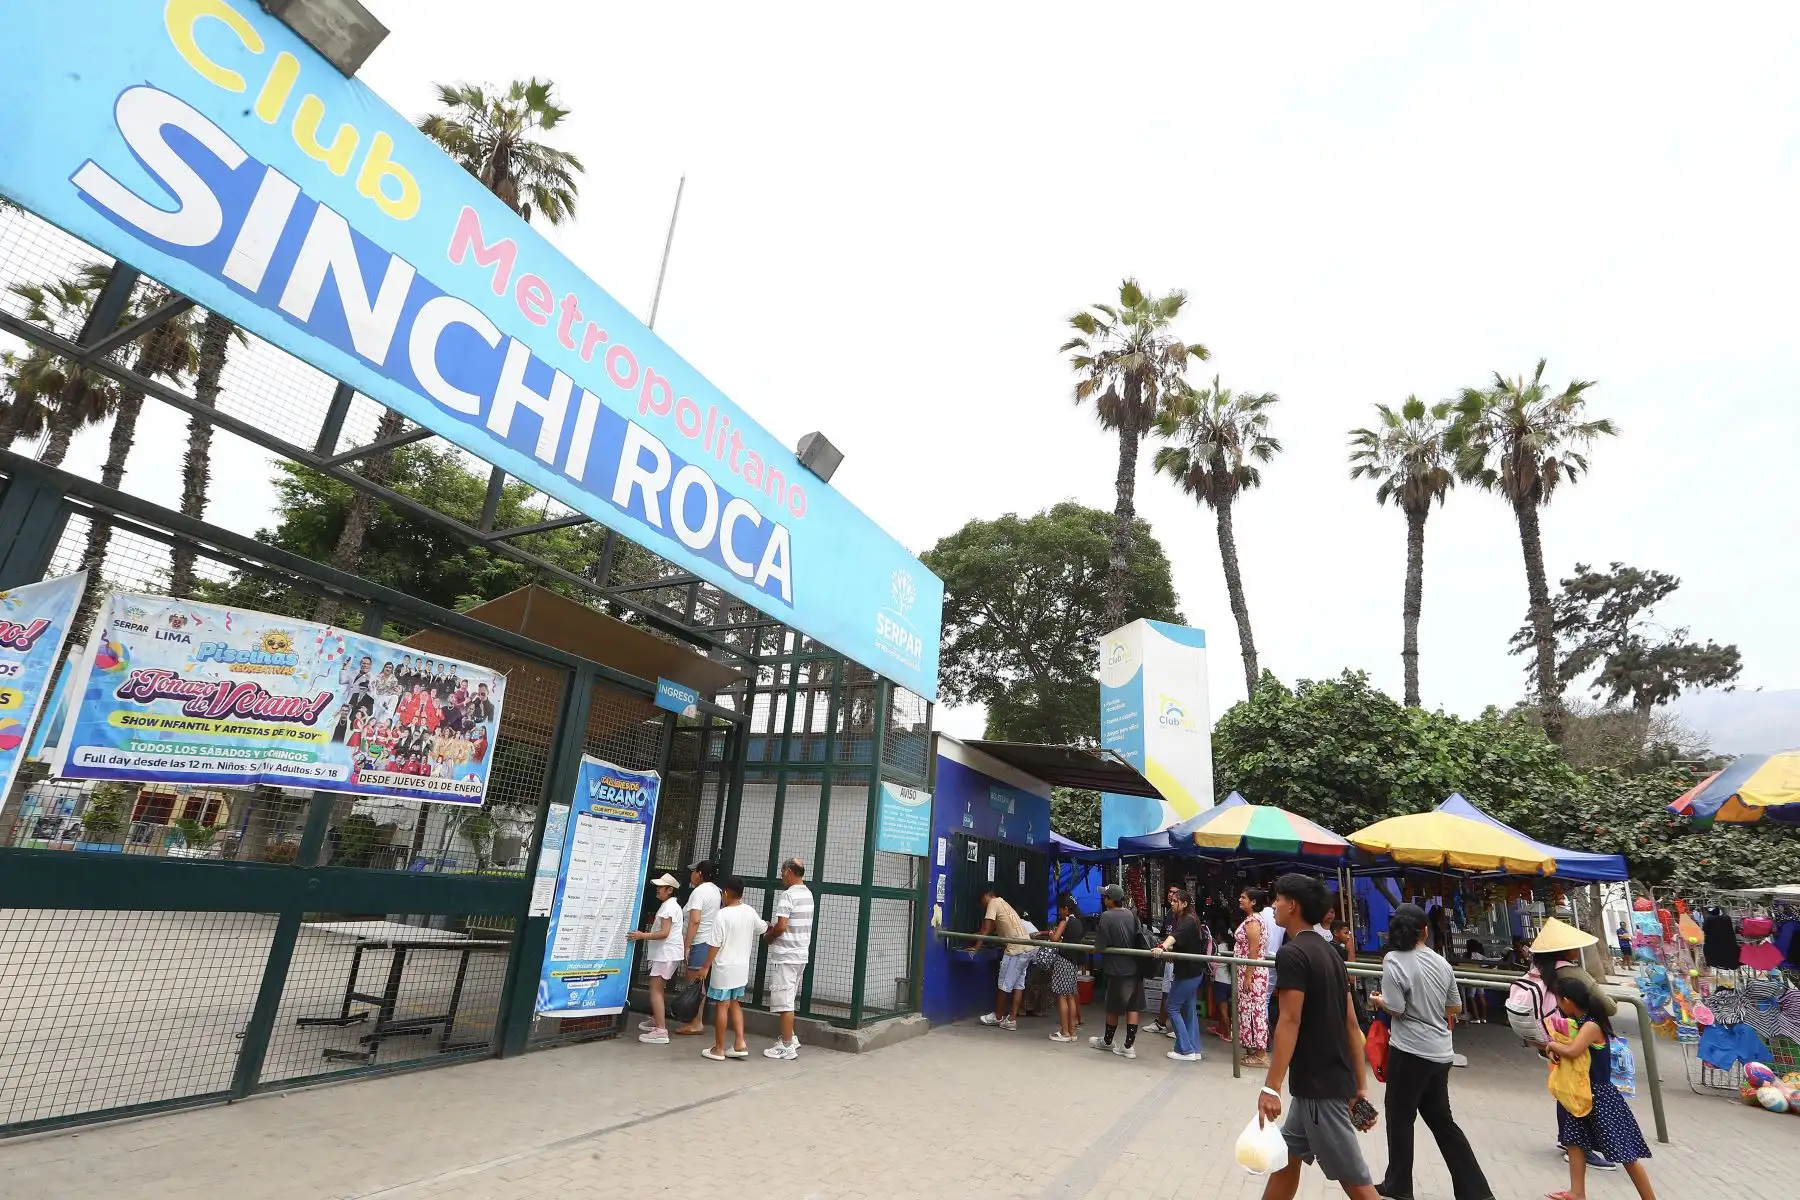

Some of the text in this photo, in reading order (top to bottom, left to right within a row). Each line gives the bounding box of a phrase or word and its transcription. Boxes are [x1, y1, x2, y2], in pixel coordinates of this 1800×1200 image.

[164, 0, 809, 520] Club Metropolitano
[70, 82, 794, 604] SINCHI ROCA
[112, 619, 150, 633] SERPAR
[875, 611, 923, 660] SERPAR
[155, 630, 191, 644] LIMA
[196, 641, 298, 667] Piscinas
[1108, 655, 1122, 666] Club
[229, 664, 297, 676] RECREATIVAS
[185, 696, 208, 712] de
[205, 681, 330, 720] Verano!
[658, 683, 694, 704] INGRESO
[120, 715, 158, 727] SHOW
[160, 718, 210, 732] INFANTIL
[213, 724, 222, 733] Y
[222, 725, 270, 737] ARTISTAS
[271, 729, 285, 738] DE
[1159, 715, 1180, 726] Club
[130, 741, 309, 762] TODOS LOS SÁBADOS Y DOMINGOS
[83, 753, 106, 764] Full
[108, 755, 132, 767] day
[133, 757, 167, 768] desde
[169, 758, 186, 769] las
[188, 760, 200, 769] 12
[202, 762, 215, 770] m.
[217, 761, 248, 771] Niños:
[275, 764, 313, 775] Adultos:
[314, 768, 326, 776] S/
[328, 769, 338, 777] 18
[359, 773, 482, 794] DESDE JUEVES 01 DE ENERO
[589, 777, 649, 808] VERANO
[899, 787, 917, 800] AVISO
